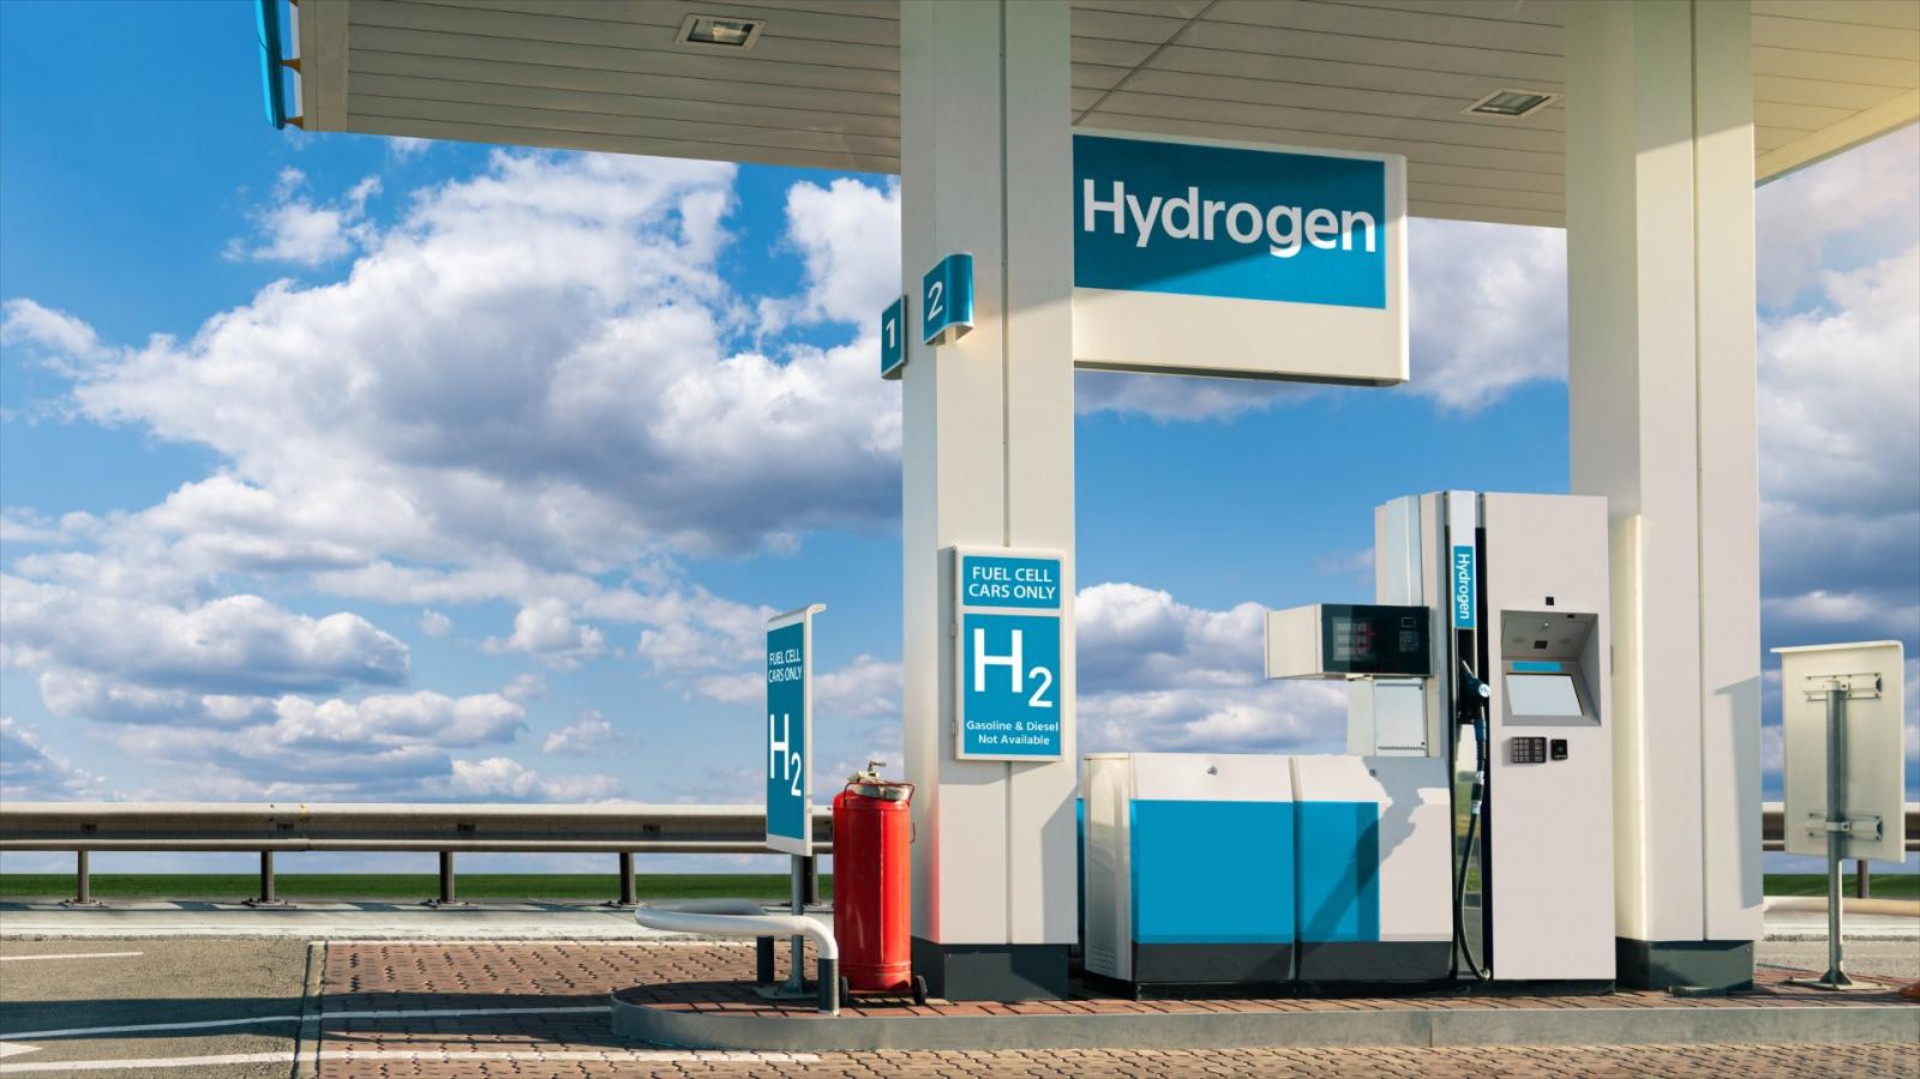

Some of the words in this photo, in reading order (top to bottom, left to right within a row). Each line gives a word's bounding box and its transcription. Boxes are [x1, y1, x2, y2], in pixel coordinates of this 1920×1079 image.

[1083, 178, 1376, 258] Hydrogen
[927, 280, 944, 322] 2
[885, 316, 896, 349] 1
[972, 566, 1011, 582] FUEL
[1014, 568, 1053, 583] CELL
[1456, 553, 1471, 620] Hydrogen
[968, 583, 1010, 598] CARS
[1013, 585, 1056, 600] ONLY
[769, 651, 784, 666] FUEL
[785, 648, 801, 664] CELL
[973, 628, 1053, 708] H2
[768, 667, 784, 683] CARS
[785, 665, 803, 681] ONLY
[966, 720, 1013, 731] Gasoline
[1014, 721, 1024, 731] &
[1026, 722, 1059, 732] Diesel
[978, 735, 999, 745] Not
[1001, 735, 1050, 746] Available
[770, 713, 802, 797] H2
